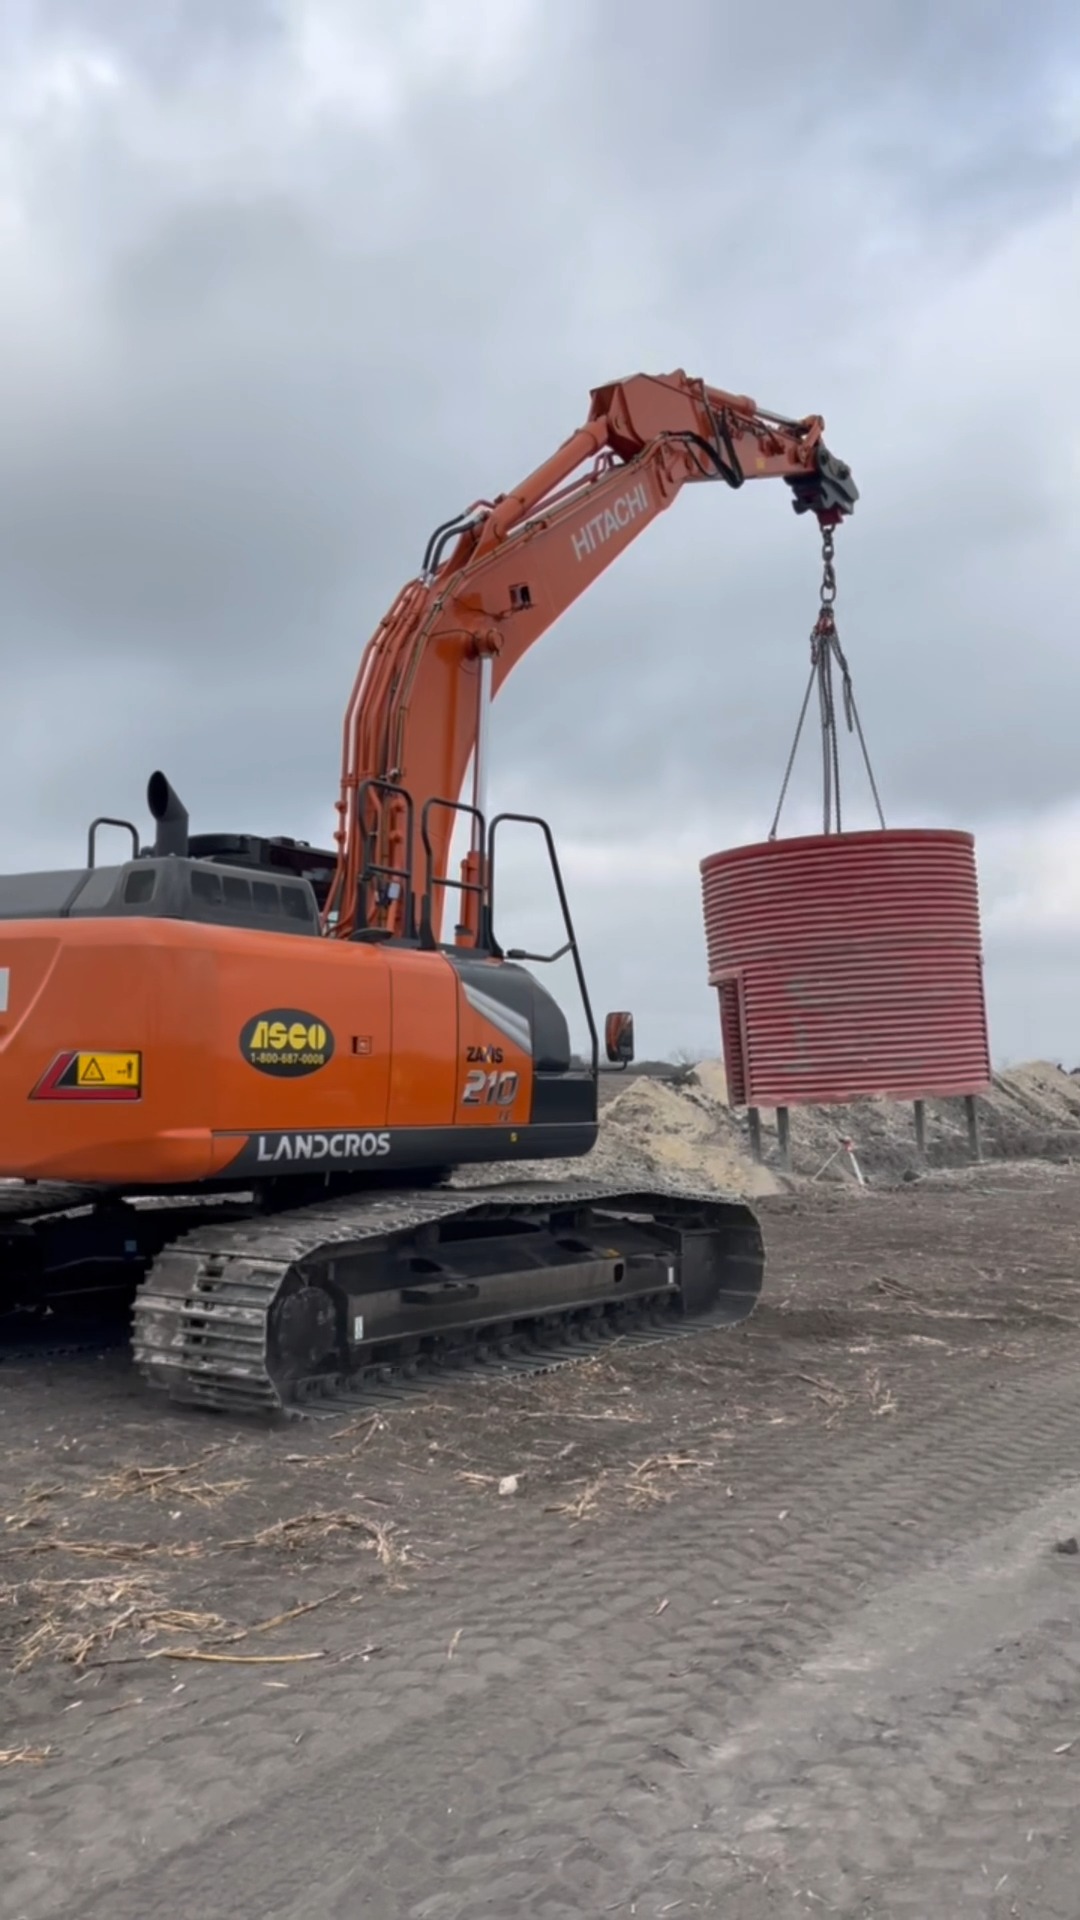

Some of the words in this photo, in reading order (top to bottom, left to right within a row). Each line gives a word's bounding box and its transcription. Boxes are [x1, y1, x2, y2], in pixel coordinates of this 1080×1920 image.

[571, 482, 648, 561] HITACHI
[250, 1021, 326, 1050] ASCO
[462, 1070, 518, 1106] 210
[257, 1132, 391, 1161] LANDCROS
